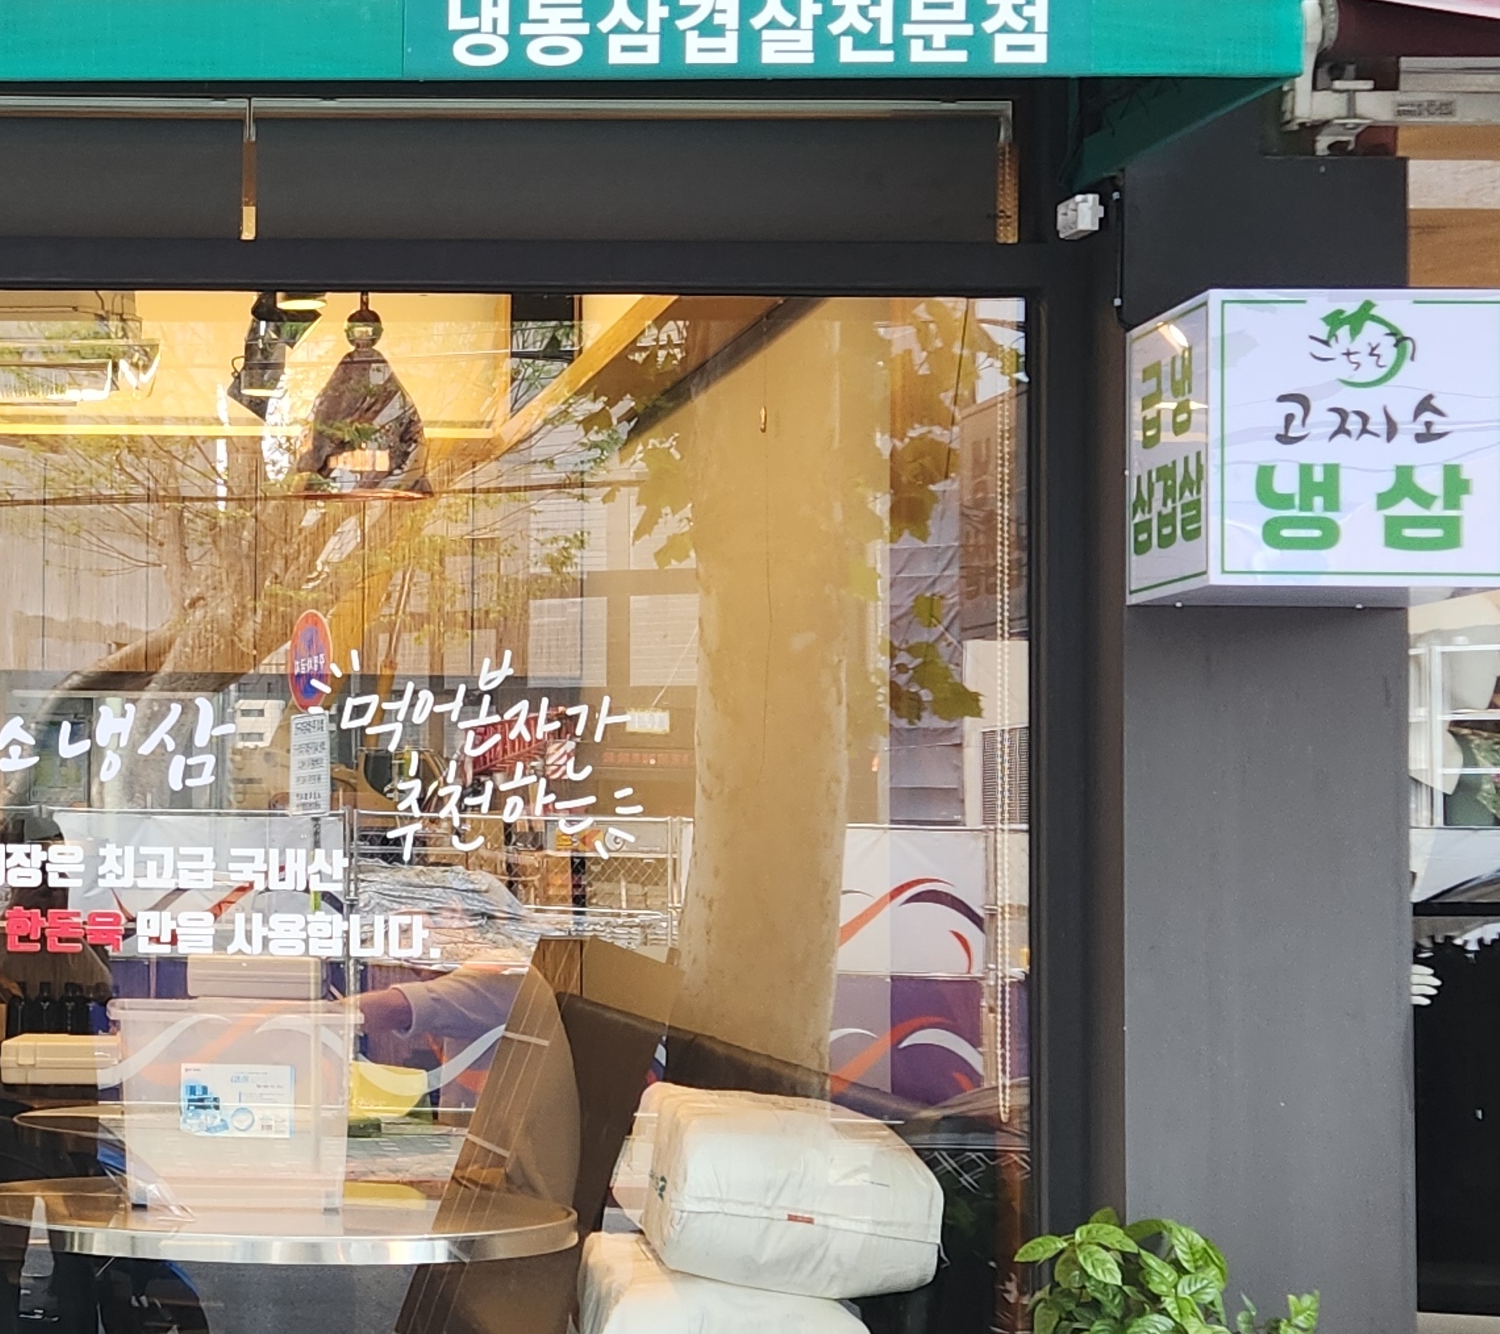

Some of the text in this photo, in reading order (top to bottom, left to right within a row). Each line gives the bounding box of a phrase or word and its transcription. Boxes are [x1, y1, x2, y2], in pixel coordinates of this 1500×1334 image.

[1274, 392, 1452, 445] 고찌소
[1132, 450, 1204, 556] 삼겹살
[97, 845, 216, 891] 최고급
[227, 847, 350, 893] 국내산
[135, 910, 216, 954] 만을
[226, 912, 442, 959] 사용합니다.
